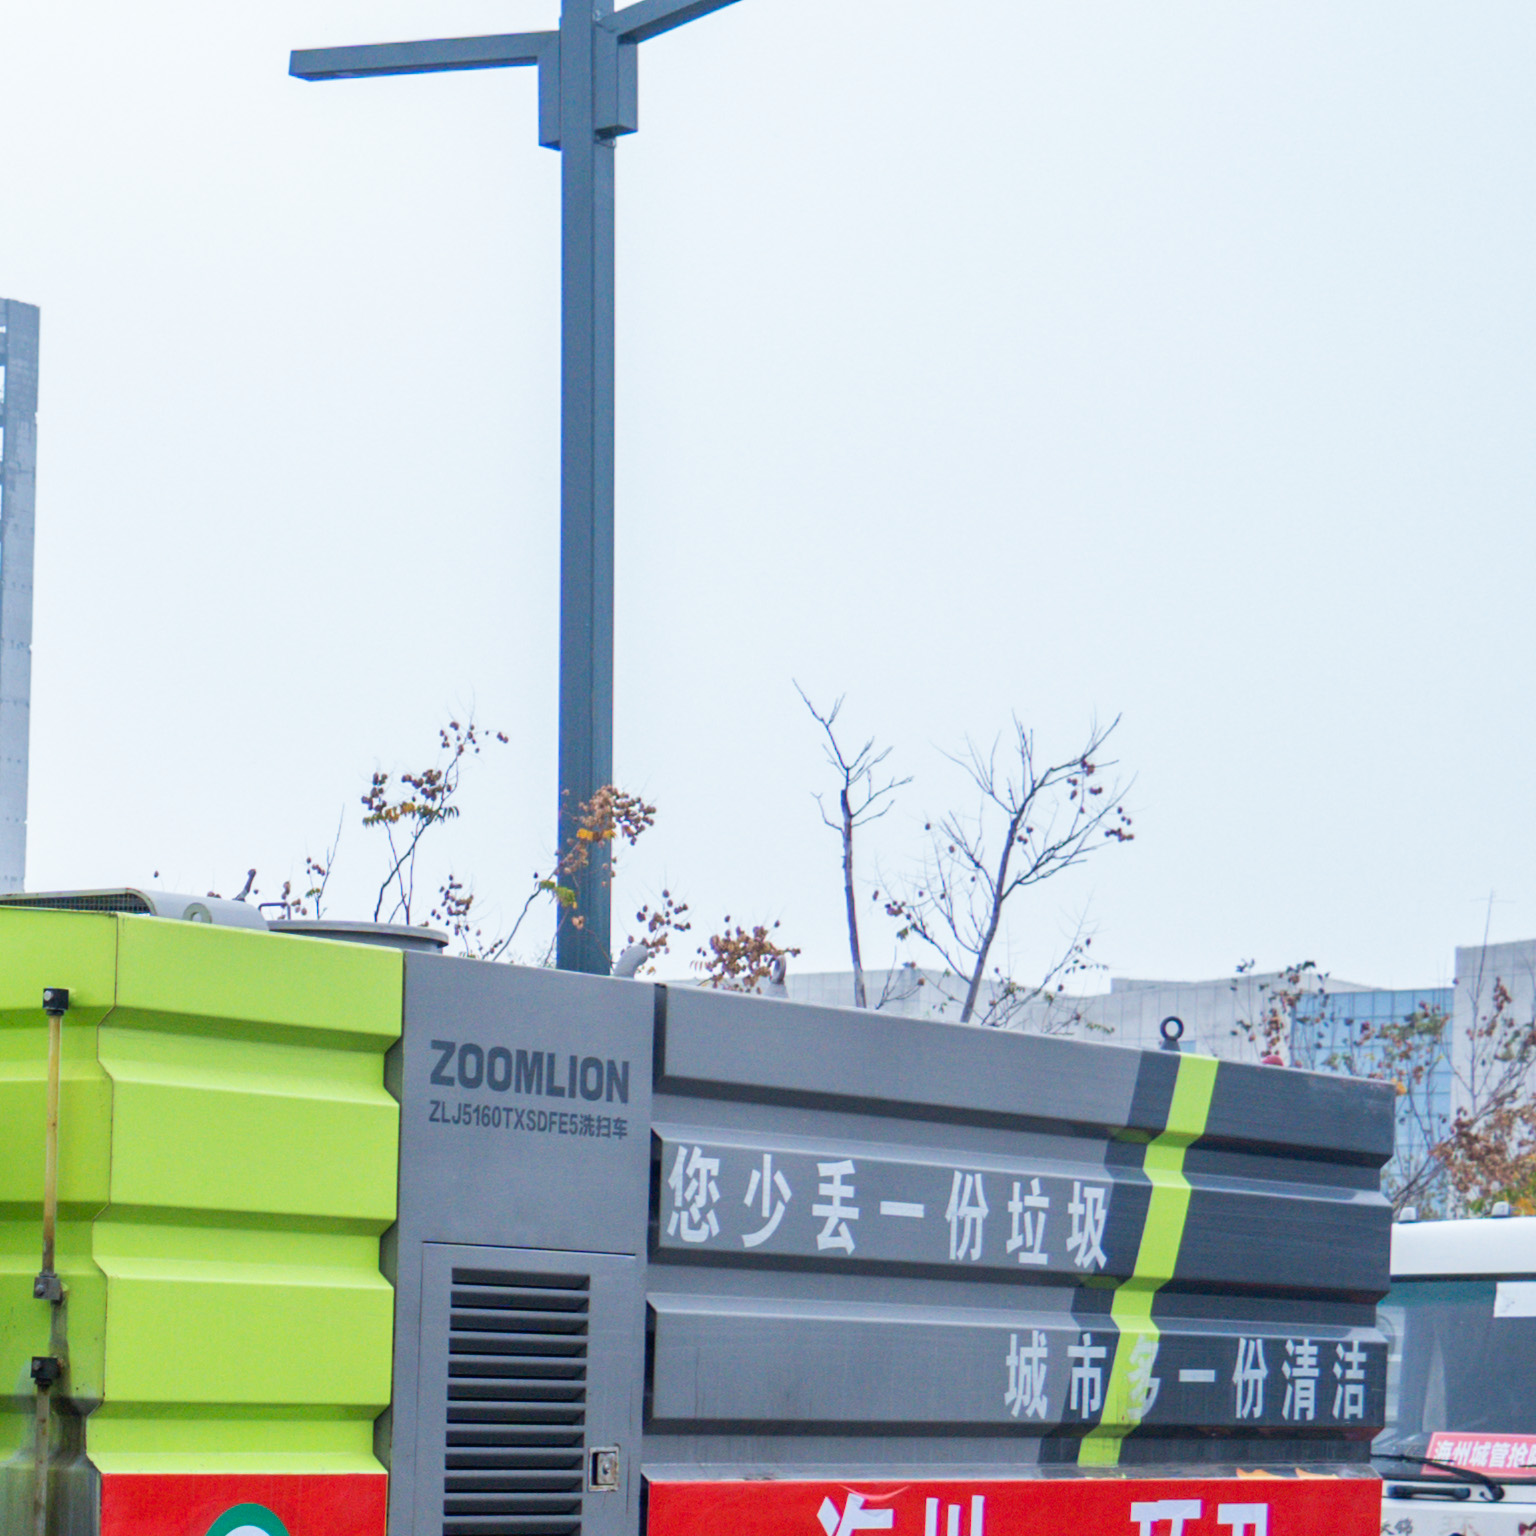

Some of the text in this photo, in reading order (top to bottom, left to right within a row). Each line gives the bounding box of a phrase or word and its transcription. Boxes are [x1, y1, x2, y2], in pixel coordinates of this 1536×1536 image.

[430, 1039, 630, 1104] ZOOMLION
[666, 1145, 1108, 1270] 您少丢一份垃圾
[1004, 1330, 1368, 1421] 城市多一份清洁
